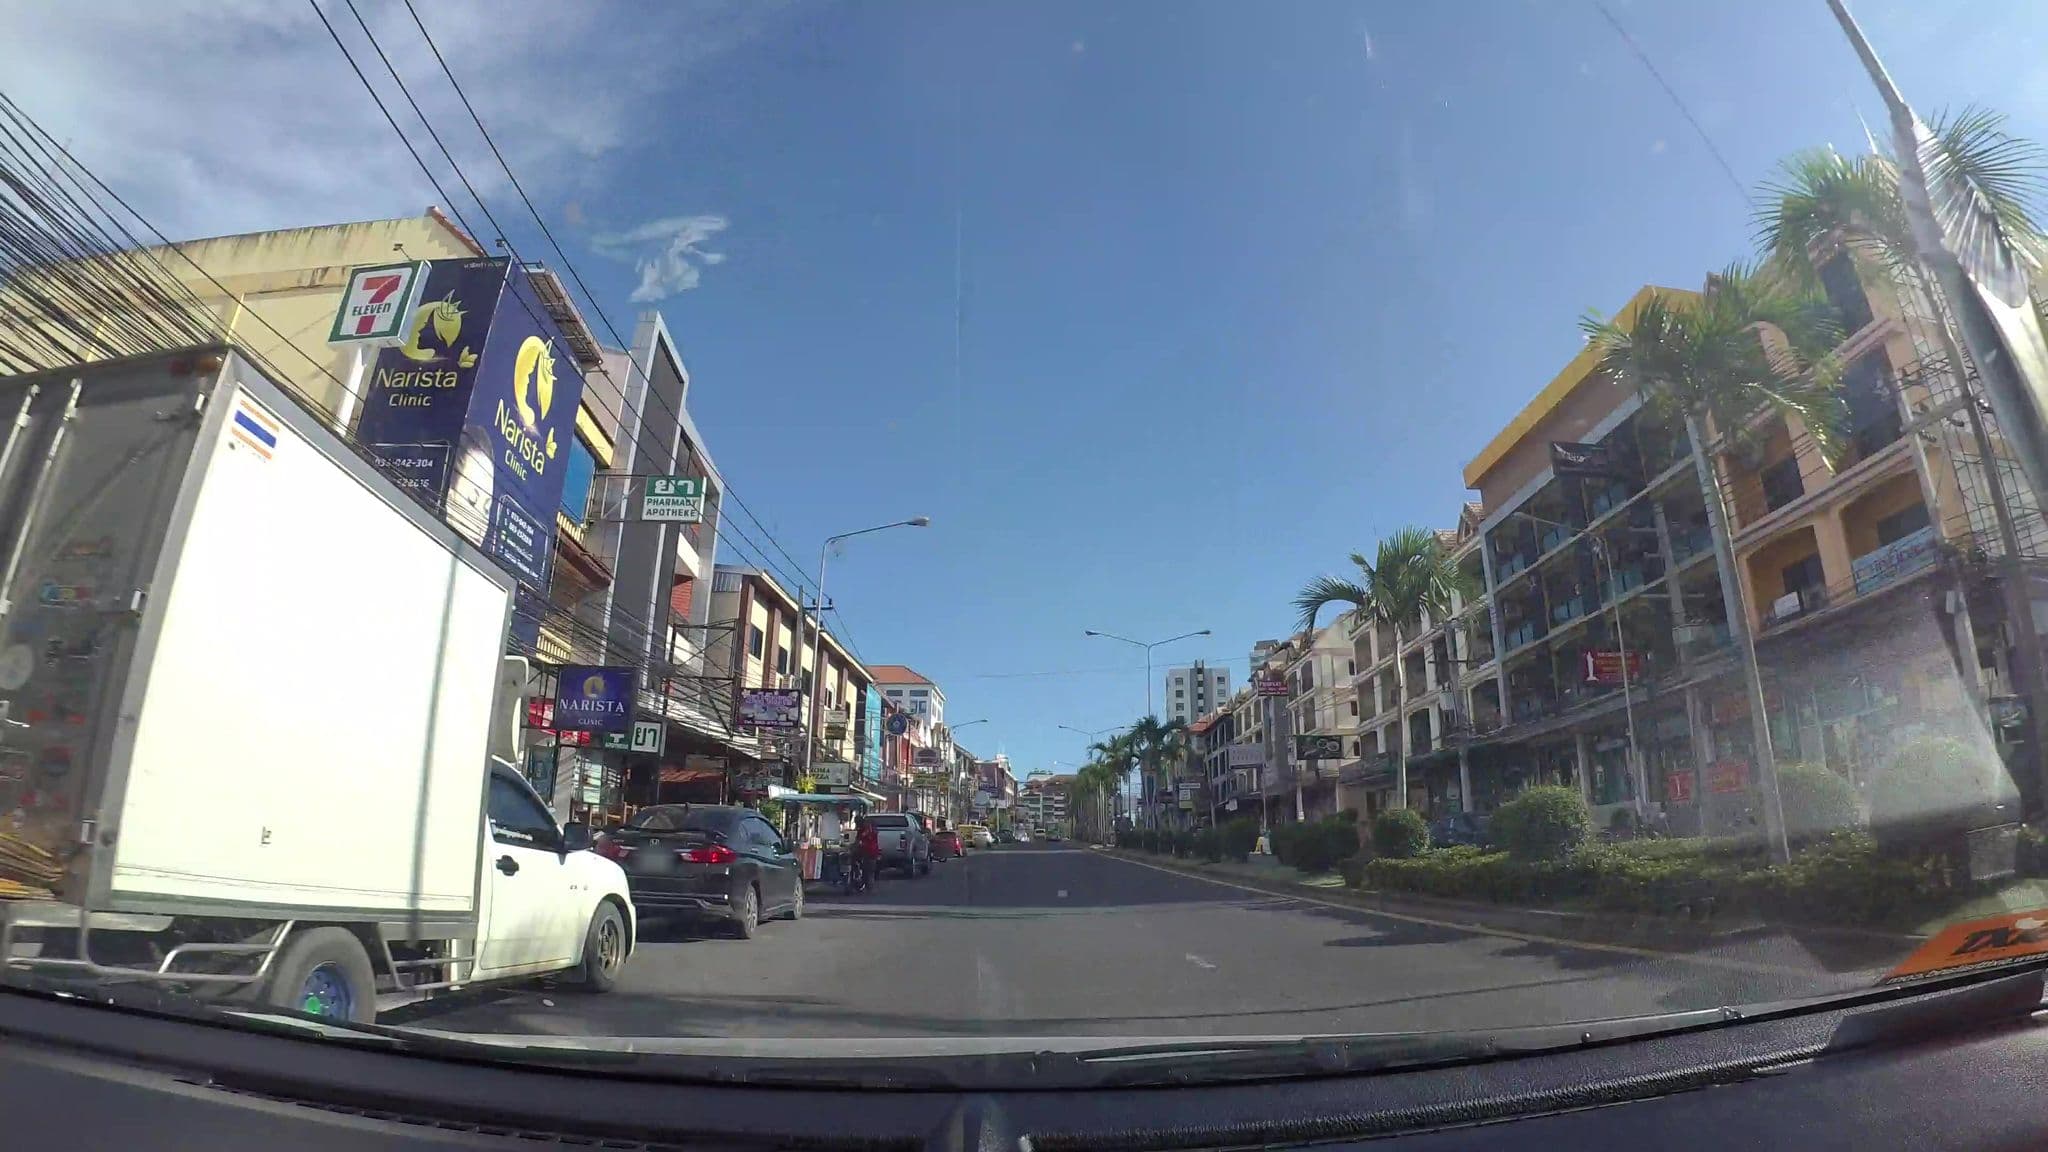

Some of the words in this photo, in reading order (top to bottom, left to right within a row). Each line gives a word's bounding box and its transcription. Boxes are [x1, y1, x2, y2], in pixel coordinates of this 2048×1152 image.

[375, 367, 458, 389] Narista
[389, 393, 432, 407] Clinic
[494, 398, 545, 476] Narista
[505, 449, 527, 480] Clinic
[645, 508, 696, 517] APOTHEKE
[560, 698, 625, 713] NARISTA
